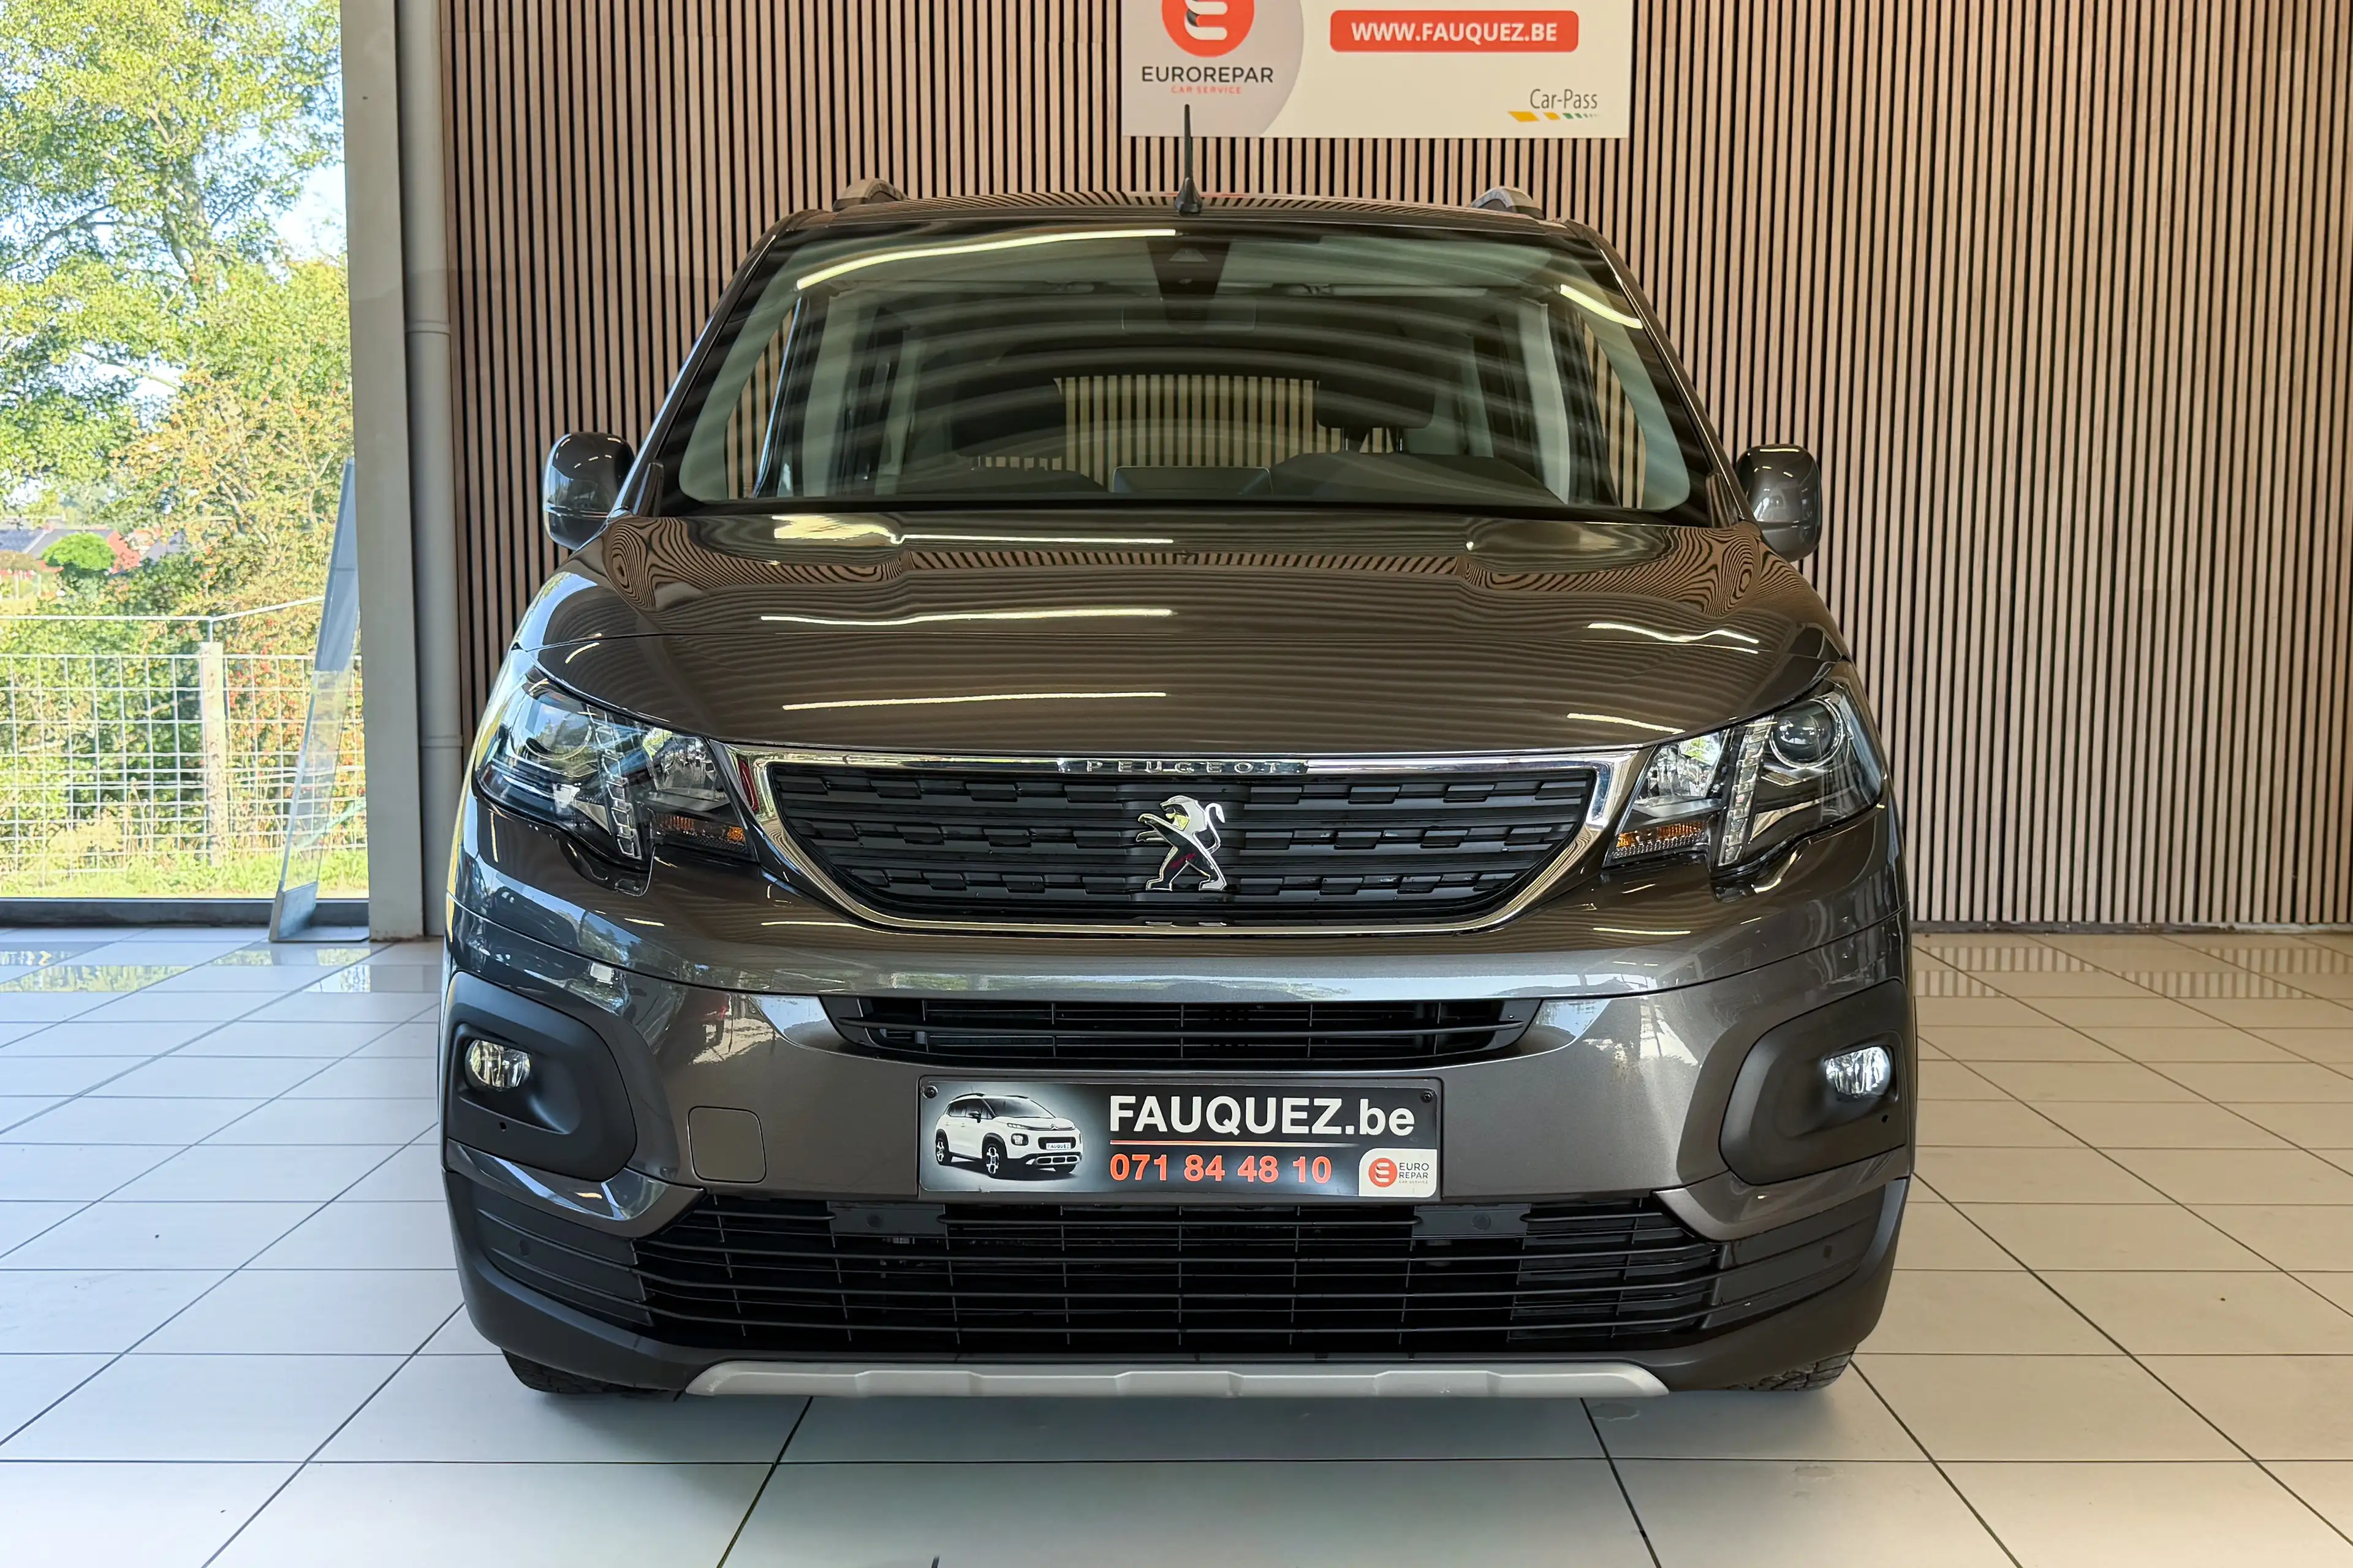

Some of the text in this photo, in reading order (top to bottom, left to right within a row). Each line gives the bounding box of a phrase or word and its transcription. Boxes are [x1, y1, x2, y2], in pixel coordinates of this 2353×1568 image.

[1351, 22, 1557, 44] WWW.FAUQUEZ.BE
[1142, 66, 1274, 83] EUROREPAR
[1529, 88, 1597, 109] Car-Pass
[1086, 760, 1281, 773] PEUGEOT
[1110, 1095, 1415, 1136] FAUQUEZ.be
[1110, 1154, 1332, 1183] 071 84 48 10
[1399, 1162, 1429, 1171] EURO
